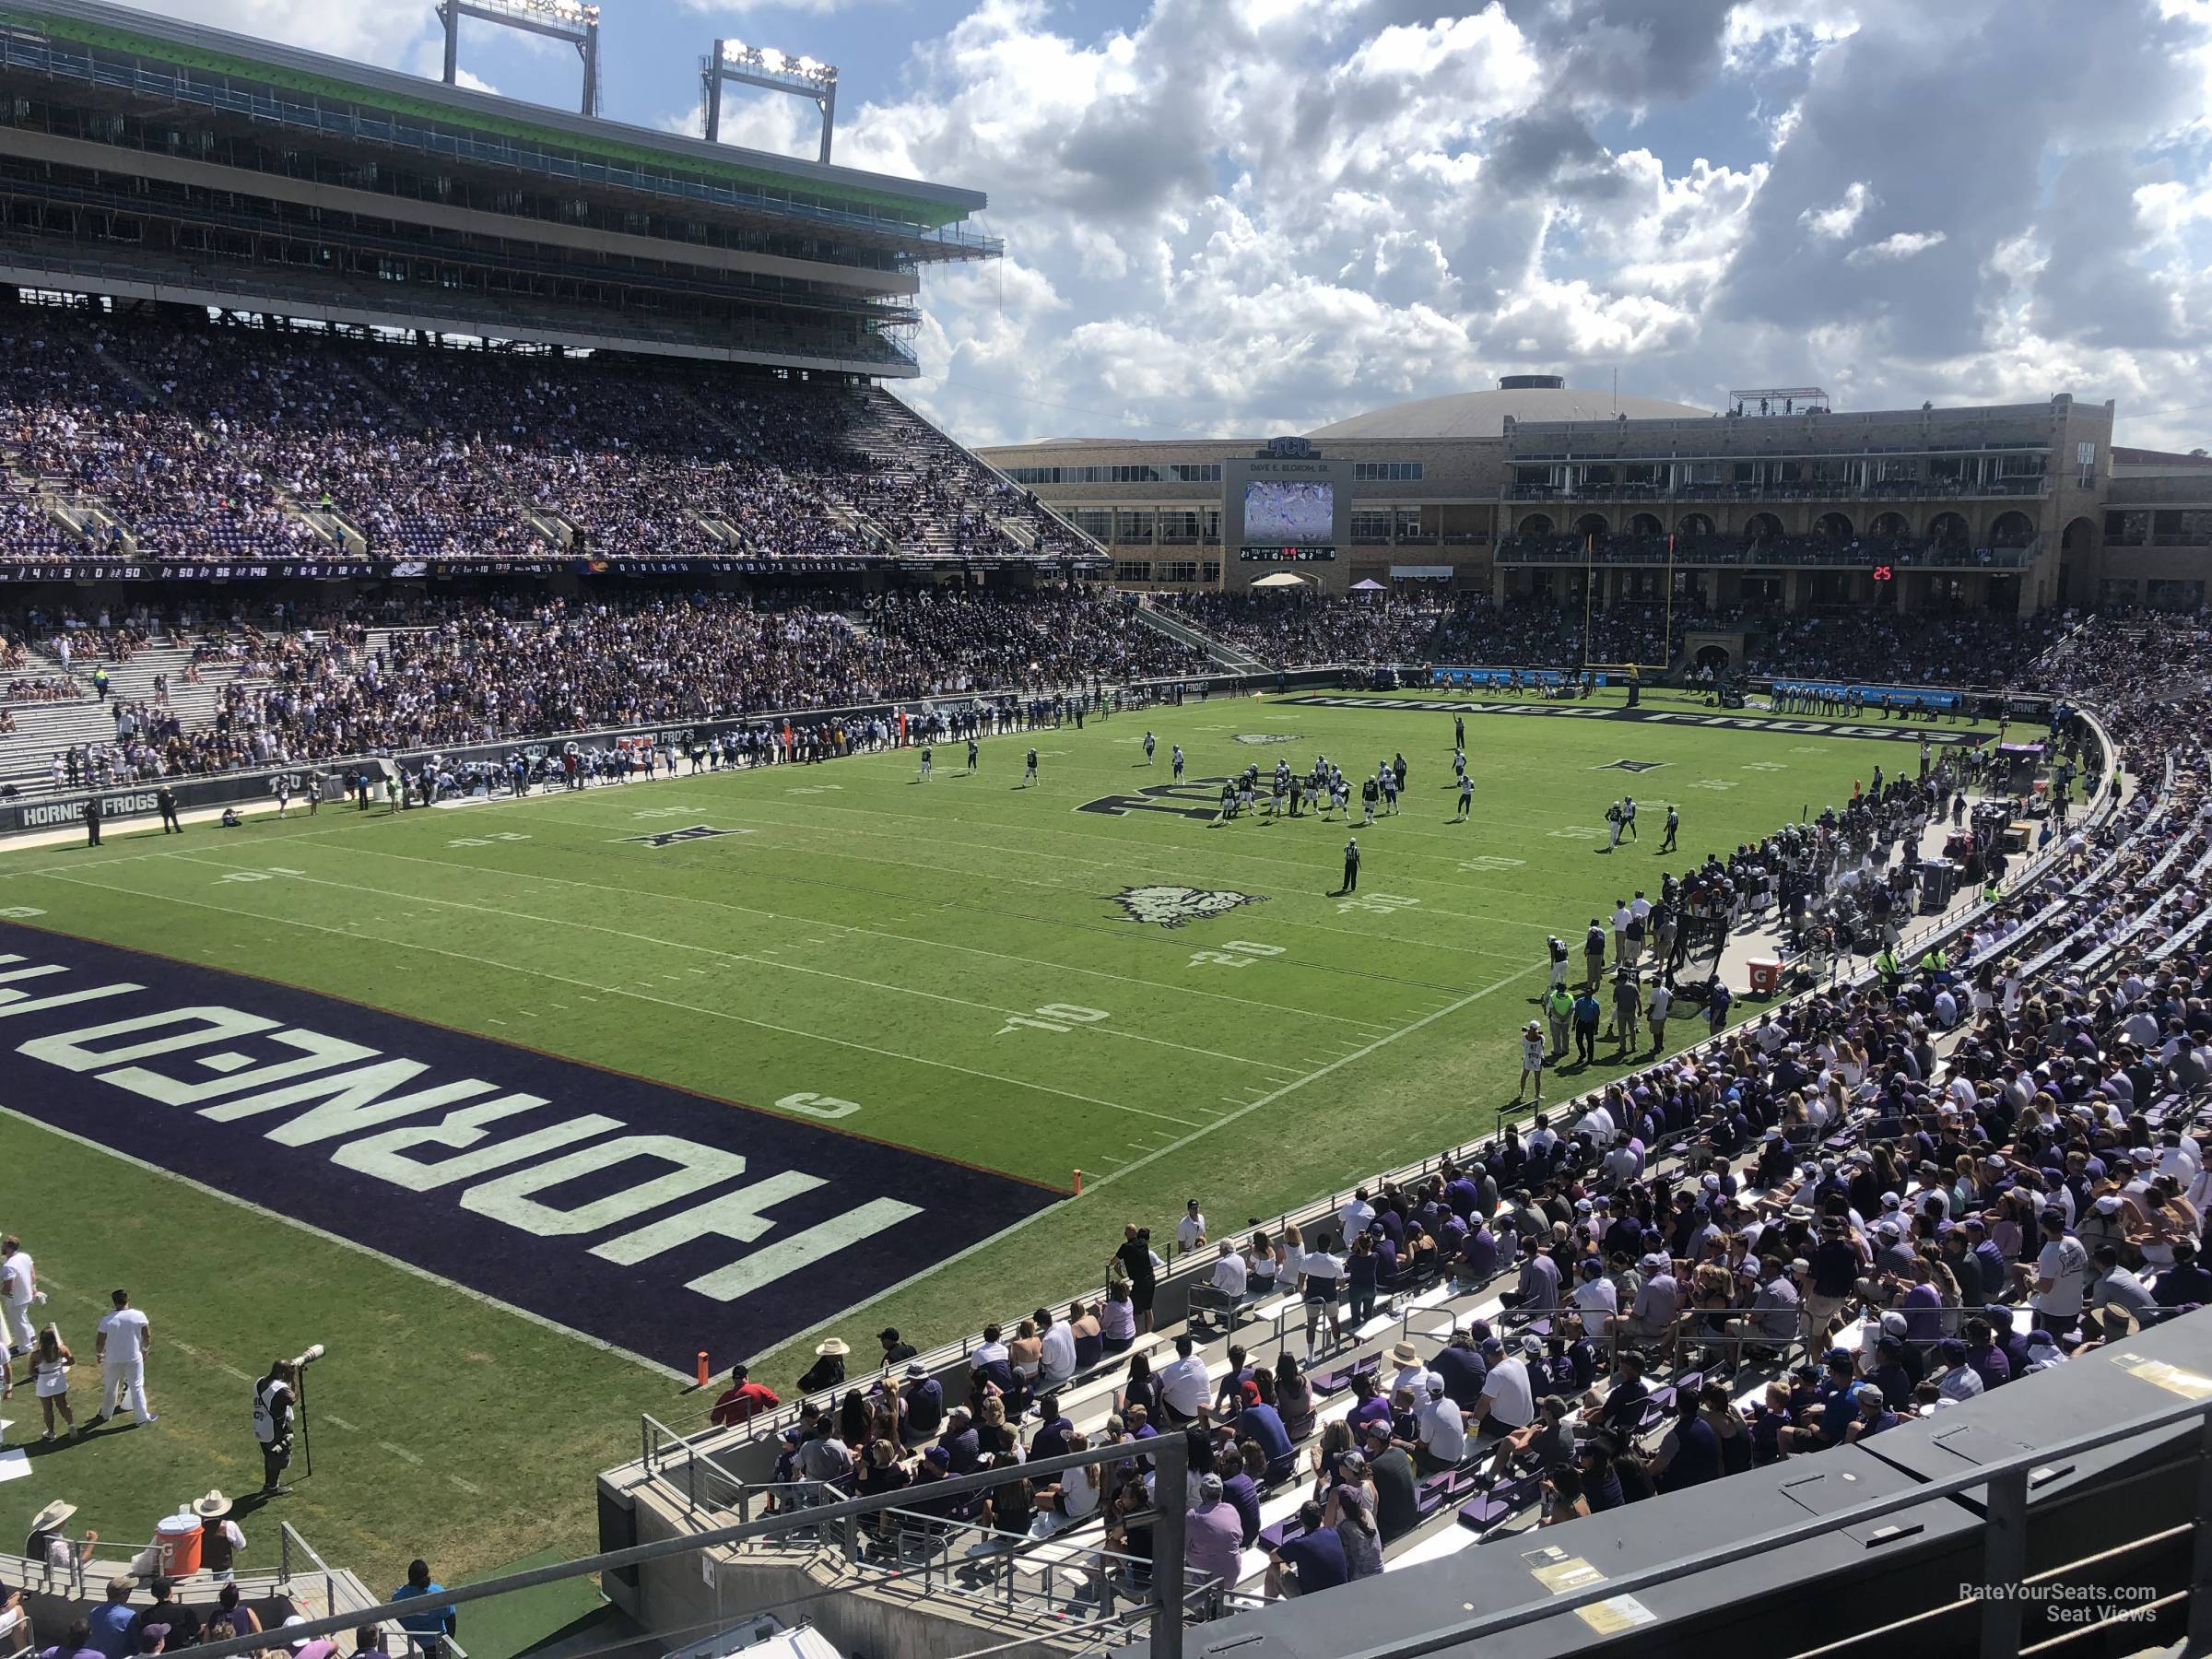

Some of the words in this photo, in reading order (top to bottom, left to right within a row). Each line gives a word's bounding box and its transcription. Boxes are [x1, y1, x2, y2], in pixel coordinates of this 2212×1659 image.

[1274, 438, 1310, 457] TCU
[33, 569, 41, 578] 4
[64, 569, 72, 578] 5
[96, 569, 102, 578] 0
[125, 569, 140, 578] 50
[179, 568, 194, 577] 50
[250, 567, 267, 577] 146
[337, 566, 347, 574] 12
[366, 566, 372, 574] 4
[1873, 566, 1891, 580] 25
[1292, 697, 1620, 717] HORNED
[1643, 713, 1966, 743] FROGS
[524, 745, 548, 757] TCU
[269, 774, 302, 795] TU
[102, 793, 158, 816] FROGS
[1339, 893, 1420, 914] 30
[1190, 940, 1288, 967] 20
[1754, 970, 1768, 983] G
[1005, 1003, 1111, 1032] 10
[15, 1006, 924, 1301] HORNED
